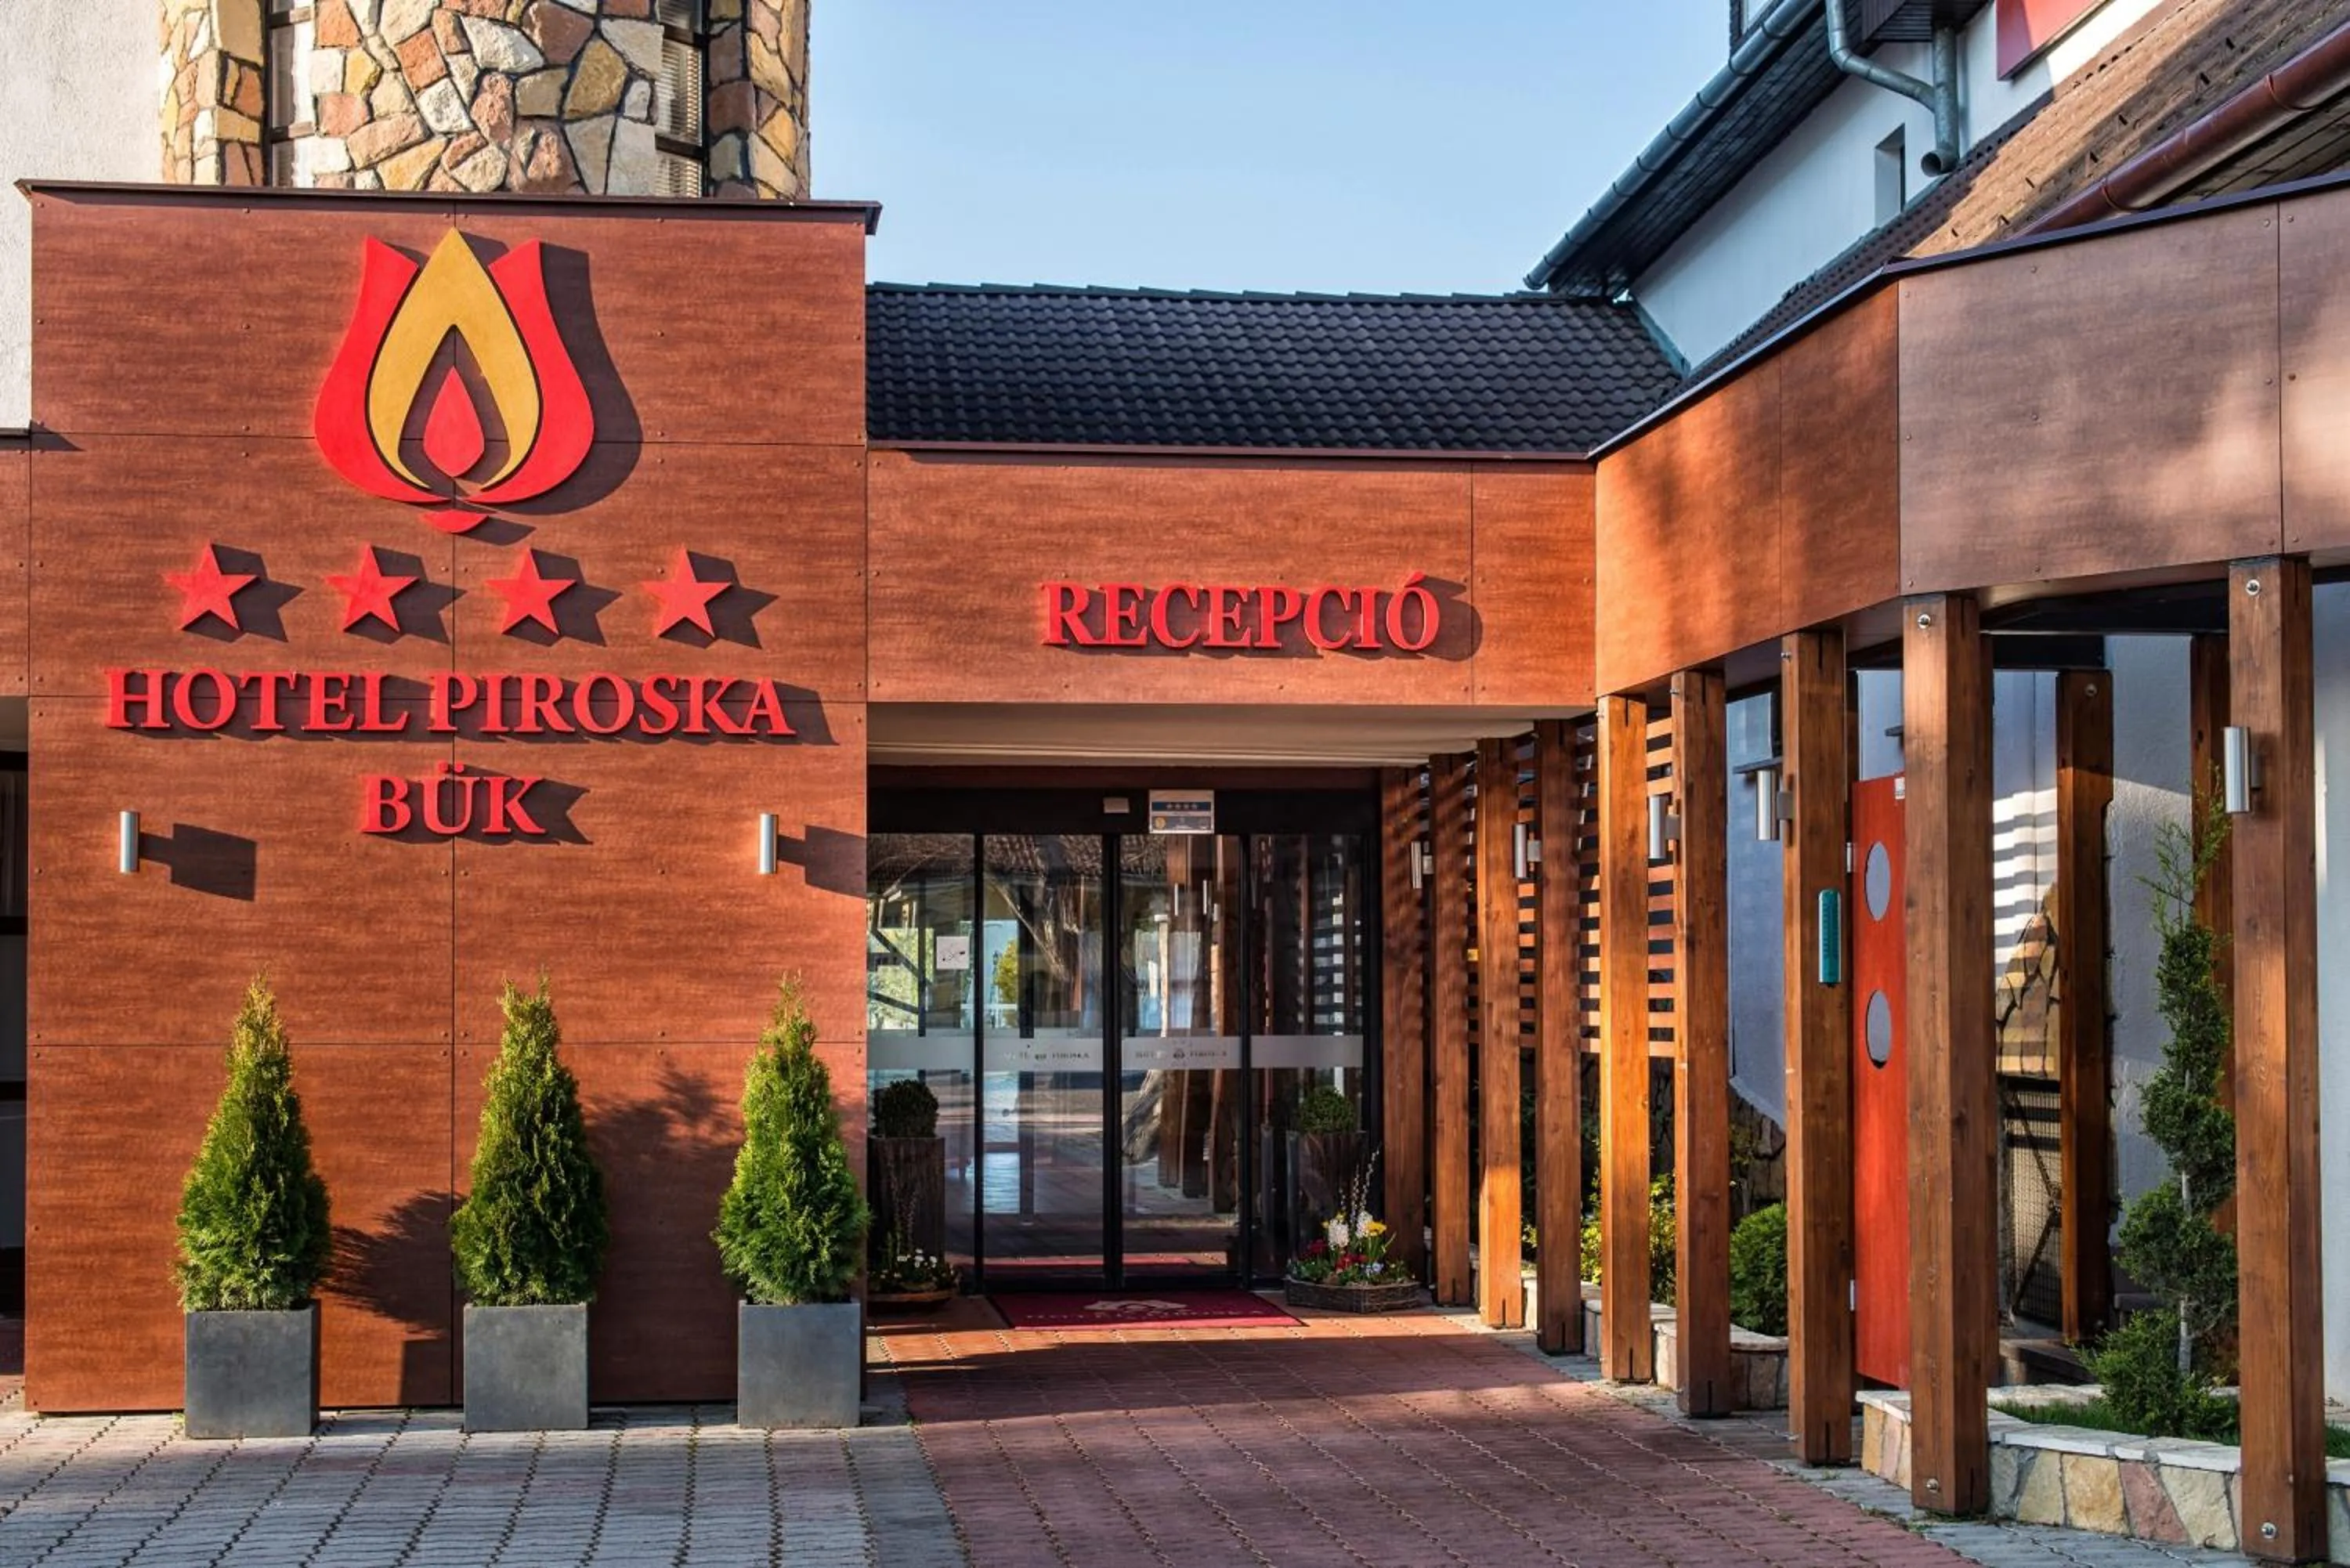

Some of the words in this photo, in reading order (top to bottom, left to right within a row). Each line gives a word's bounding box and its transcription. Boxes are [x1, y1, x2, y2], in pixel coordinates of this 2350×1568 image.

[1041, 572, 1440, 651] RECEPCIÓ
[104, 668, 409, 732] HOTEL
[428, 671, 794, 736] PIROSKA
[360, 762, 546, 834] BÜK
